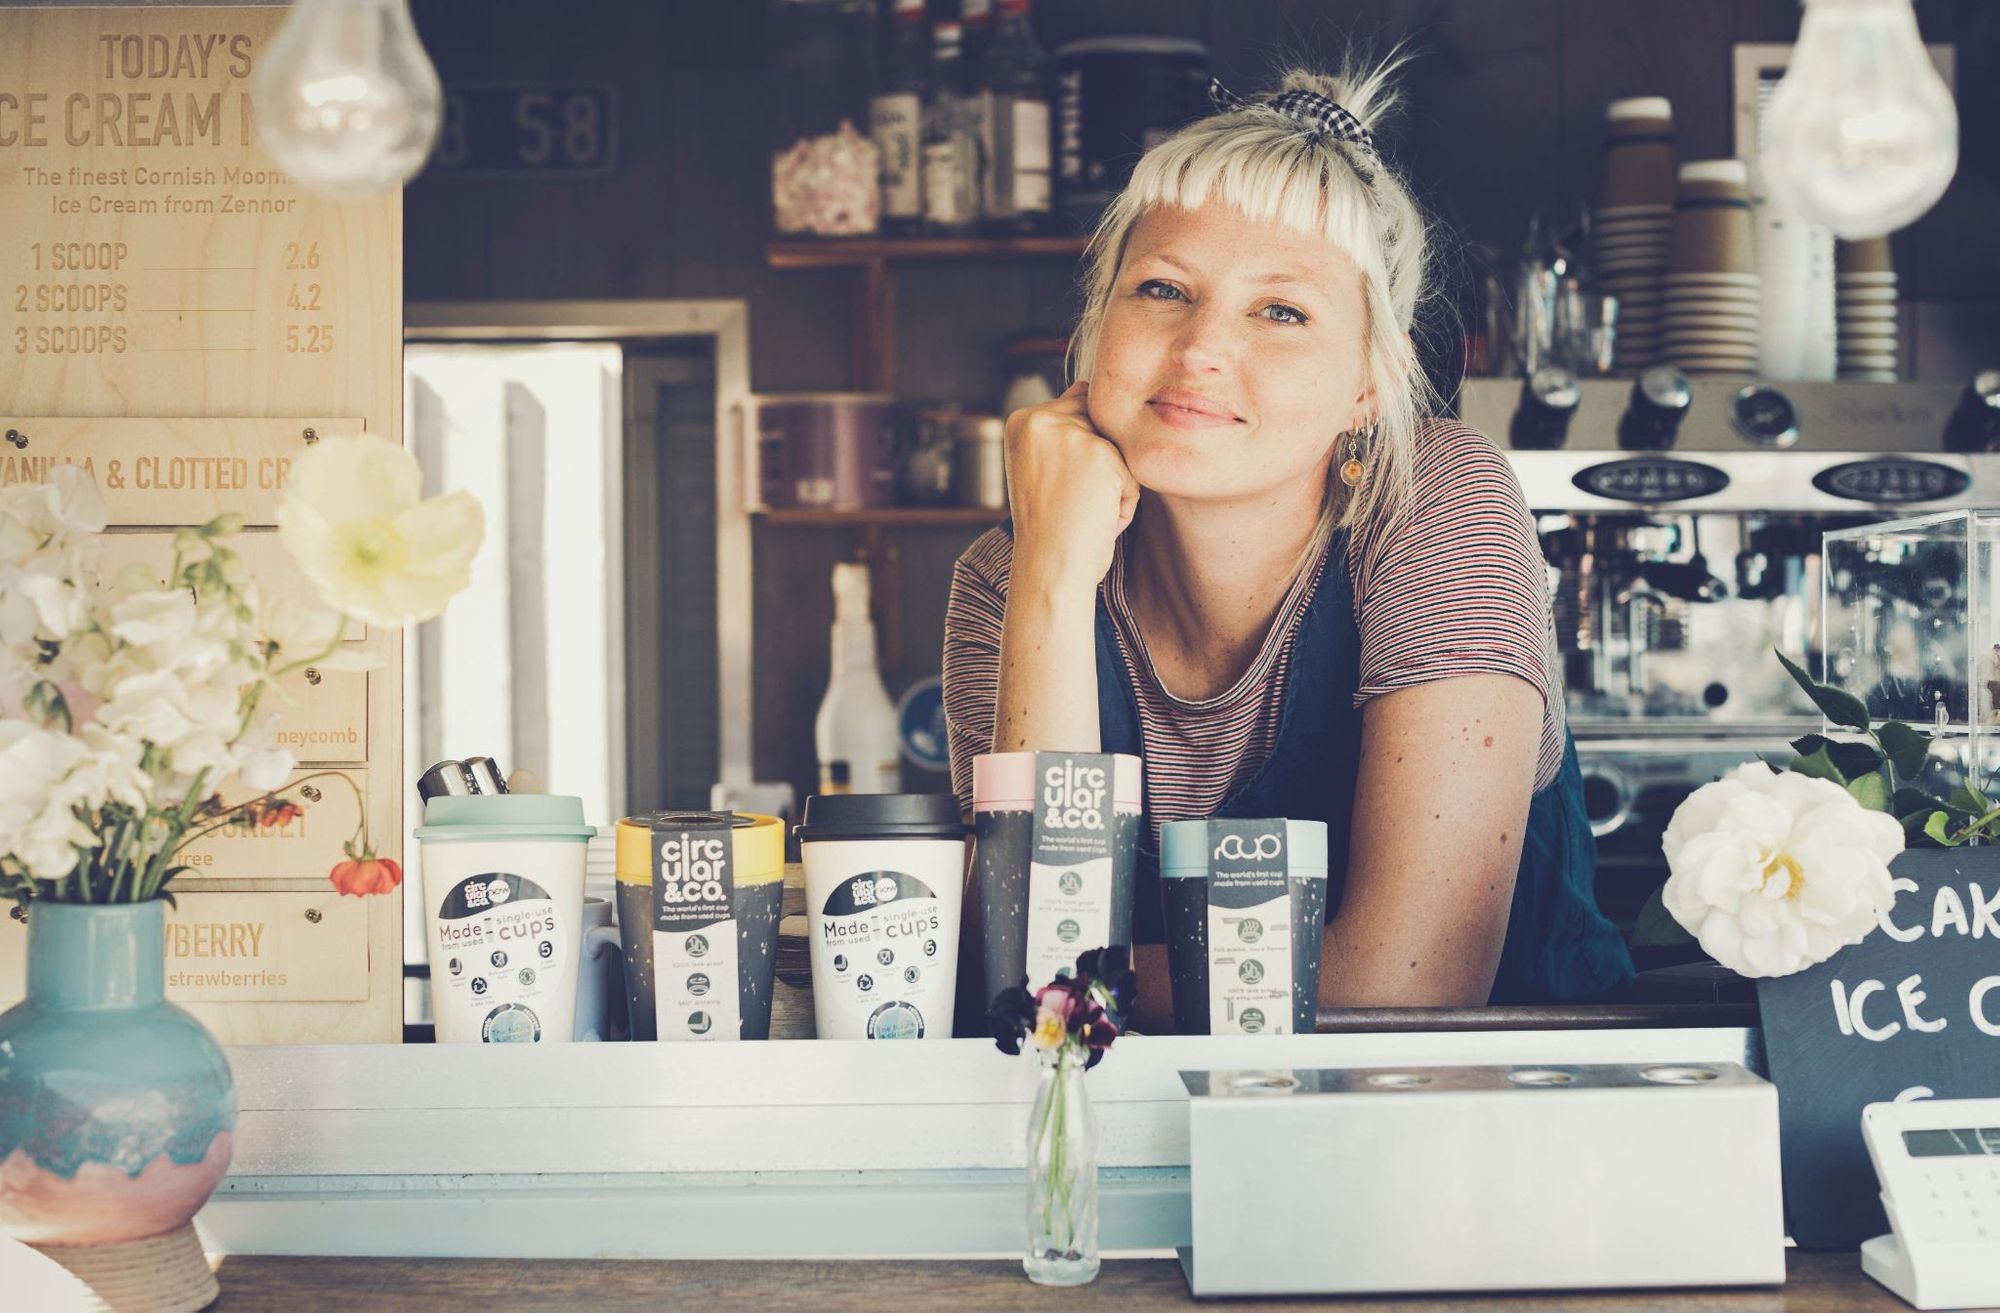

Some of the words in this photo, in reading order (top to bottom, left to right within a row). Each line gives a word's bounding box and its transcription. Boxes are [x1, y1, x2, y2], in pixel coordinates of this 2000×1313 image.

[100, 34, 253, 79] TODAY'S
[0, 92, 48, 147] CE
[64, 92, 221, 147] CREAM
[24, 167, 61, 185] The
[68, 167, 127, 185] finest
[135, 167, 215, 185] Cornish
[52, 196, 81, 214] Ice
[89, 196, 157, 214] Cream
[164, 196, 213, 214] from
[221, 195, 296, 214] Zennor
[31, 243, 42, 270] 1
[52, 243, 127, 270] SCOOP
[286, 242, 319, 270] 2.6
[15, 285, 28, 312] 2
[35, 285, 128, 312] SCOOPS
[287, 283, 321, 311] 4.2
[15, 326, 28, 354] 3
[35, 326, 127, 354] SCOOPS
[286, 325, 334, 353] 5.25
[107, 460, 125, 489] &
[135, 457, 248, 489] CLOTTED
[277, 727, 358, 747] neycomb
[1045, 759, 1105, 787] circ
[1044, 786, 1106, 808] ular
[661, 833, 724, 862] circ
[661, 859, 725, 882] ular
[164, 922, 264, 957] BERRY
[440, 923, 482, 942] Made
[499, 917, 555, 940] cups
[824, 921, 869, 939] Made
[886, 916, 939, 938] cups
[169, 970, 288, 987] strawberries
[1831, 974, 1947, 1041] ICE
